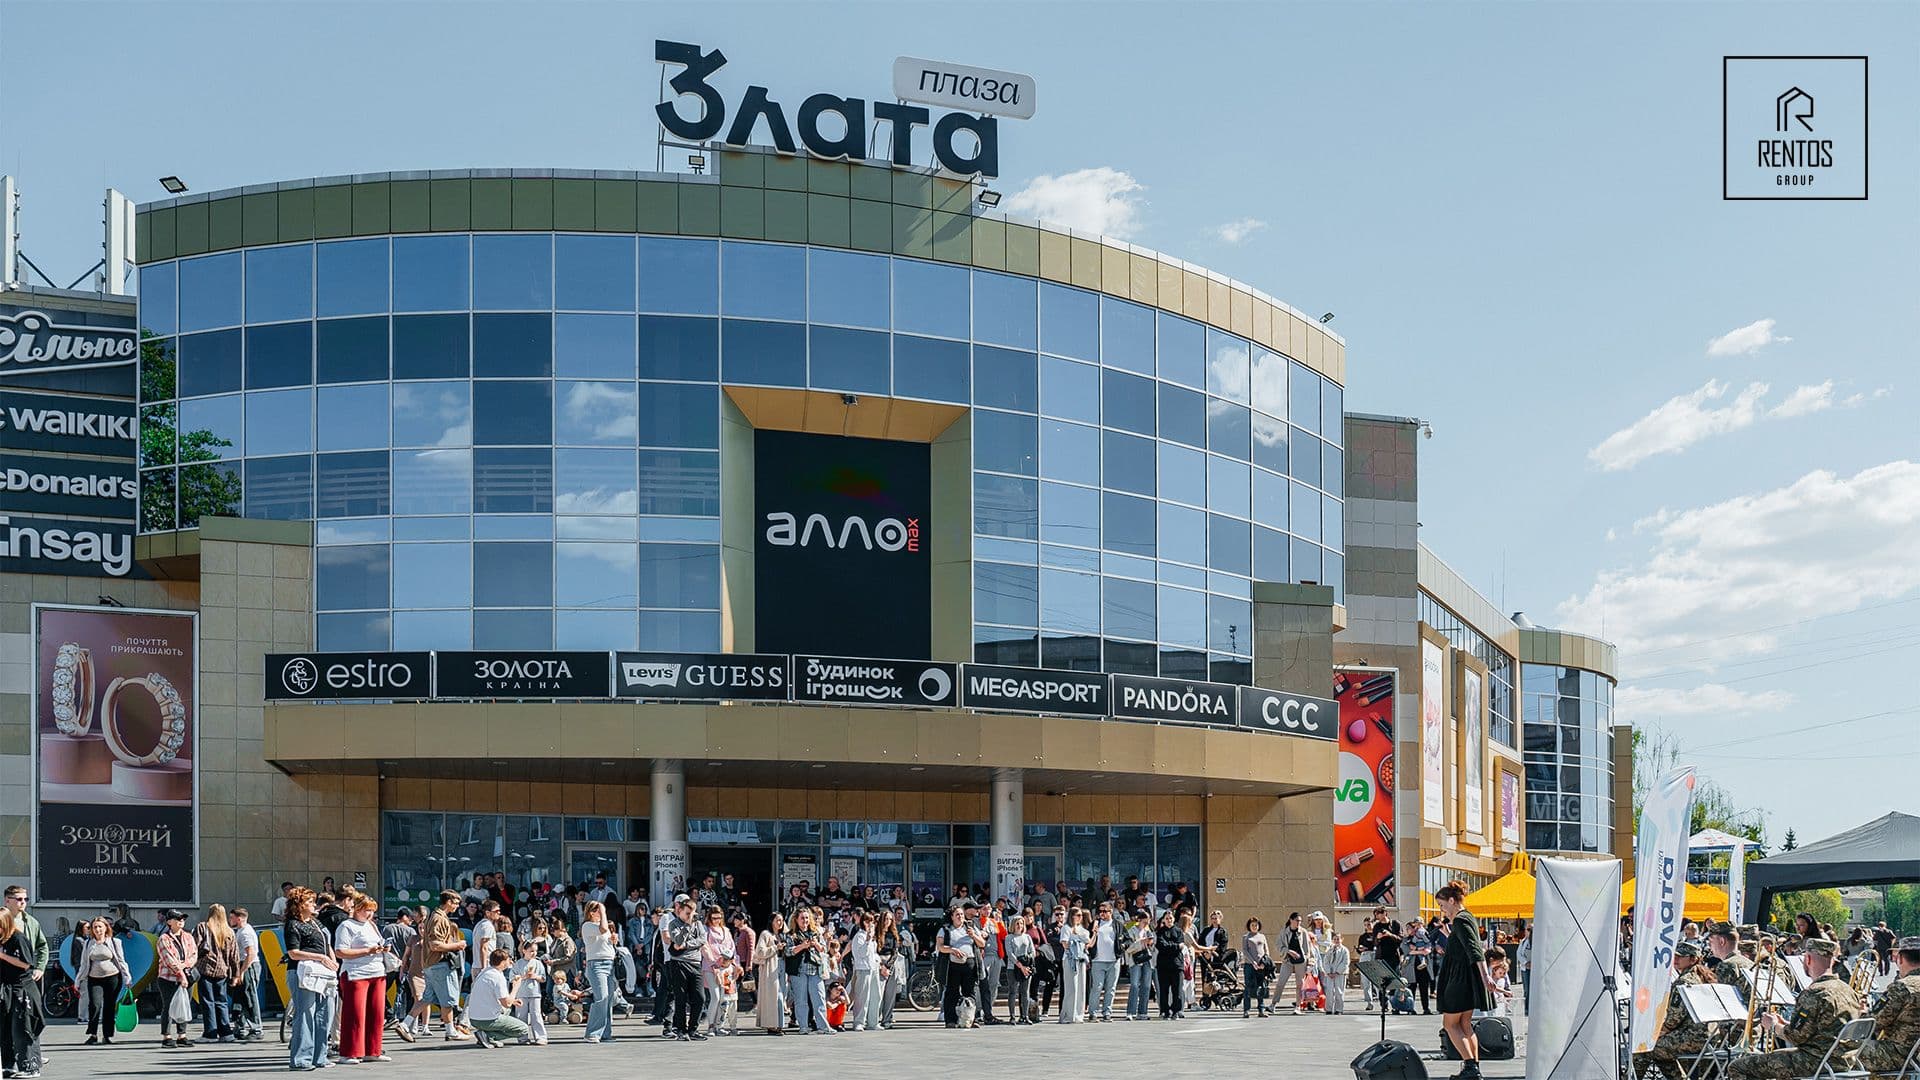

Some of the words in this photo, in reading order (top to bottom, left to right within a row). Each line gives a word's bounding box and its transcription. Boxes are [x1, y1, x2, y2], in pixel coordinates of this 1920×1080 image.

[918, 69, 1021, 106] плаза
[655, 39, 999, 179] Злата
[907, 517, 919, 552] max
[111, 645, 184, 656] ПРИКРАШАЮТЬ
[126, 637, 168, 646] ПОЧУТТЯ
[326, 659, 412, 688] estro
[474, 660, 573, 679] ЗОЛОТА
[685, 664, 783, 687] GUESS
[806, 659, 895, 680] будинок
[970, 676, 1101, 702] MEGASPORT
[1123, 687, 1228, 716] PANDORA
[1262, 696, 1319, 731] CCC
[69, 866, 128, 876] ювелірний
[132, 868, 164, 876] завод
[1653, 857, 1674, 969] Злата
